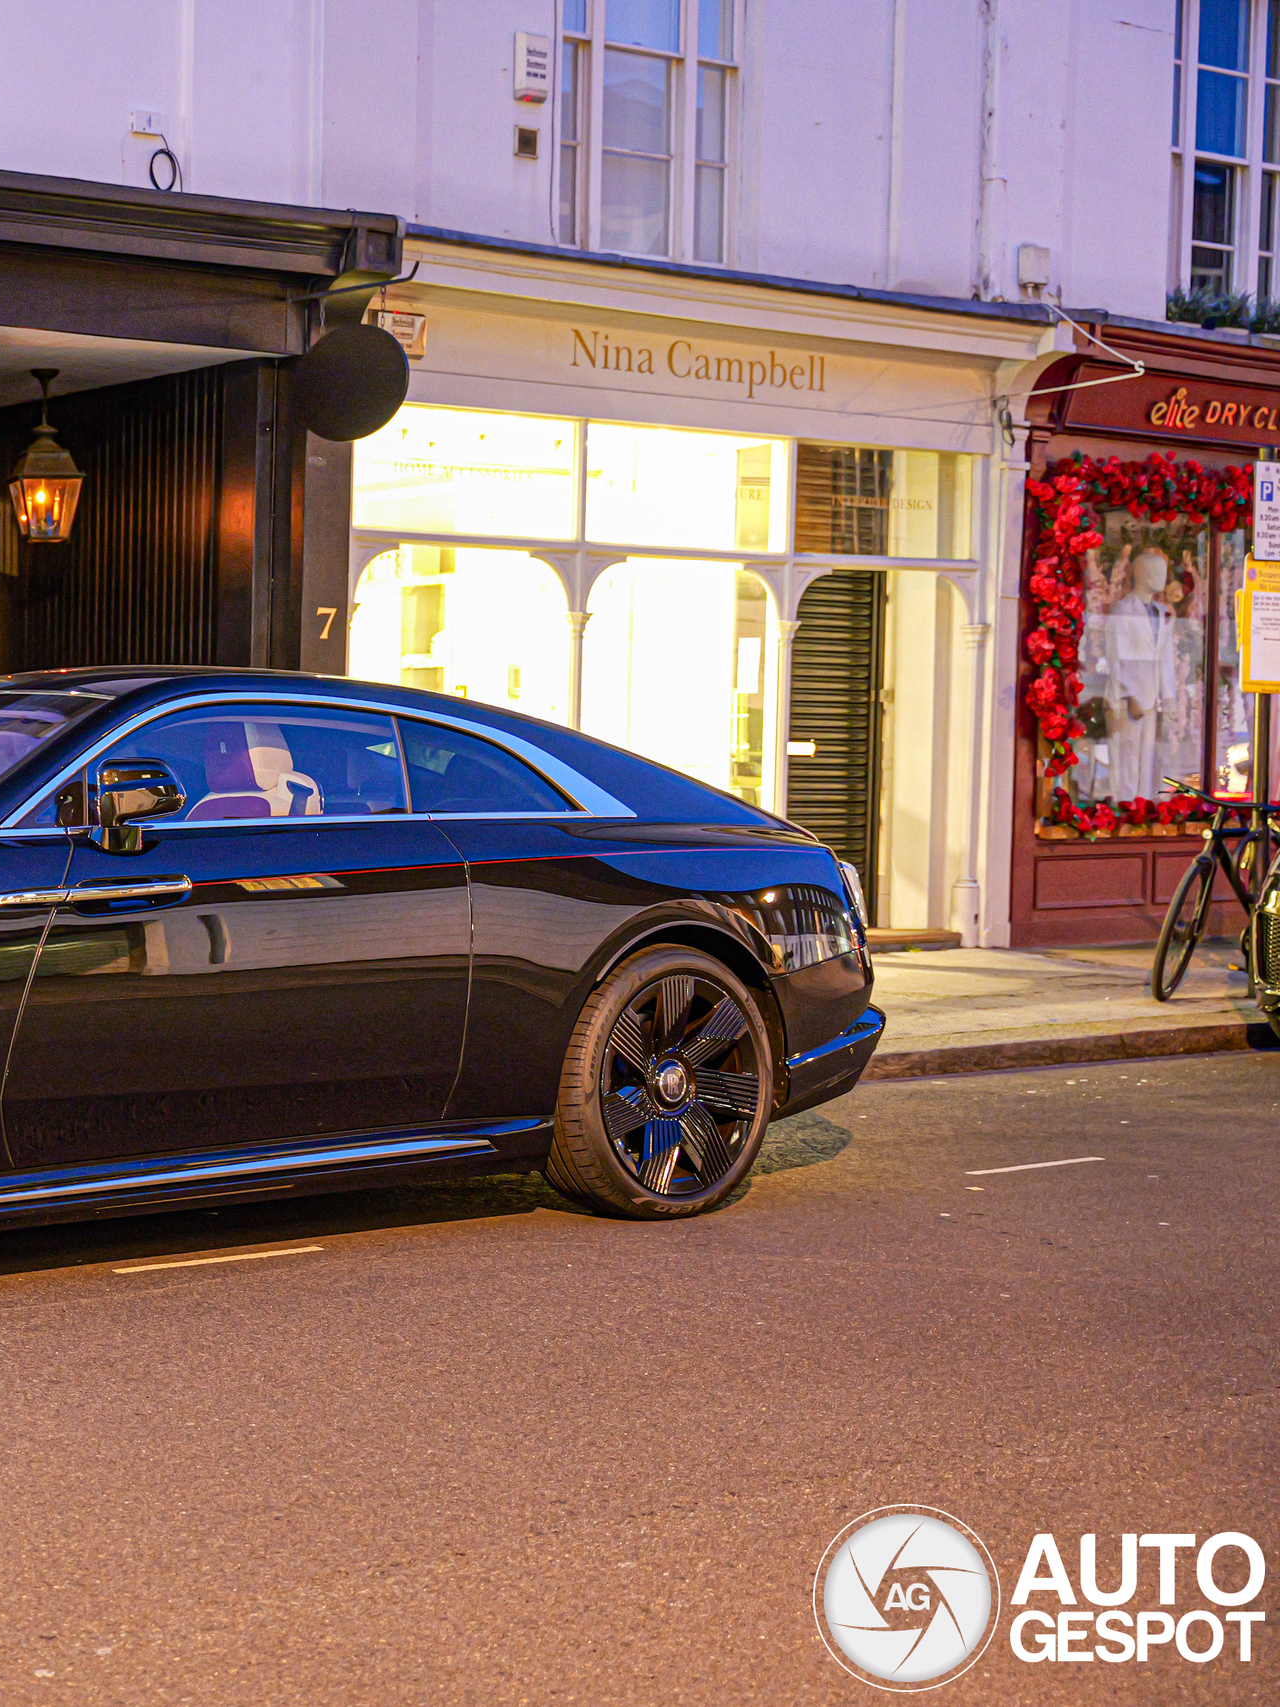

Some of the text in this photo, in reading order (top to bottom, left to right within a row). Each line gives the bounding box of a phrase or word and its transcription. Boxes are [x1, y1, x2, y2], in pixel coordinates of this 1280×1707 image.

[570, 329, 826, 399] Nina Campbell
[1151, 387, 1200, 429] elite
[1205, 401, 1252, 426] DRY
[892, 497, 933, 511] DESIGN
[316, 606, 338, 640] 7
